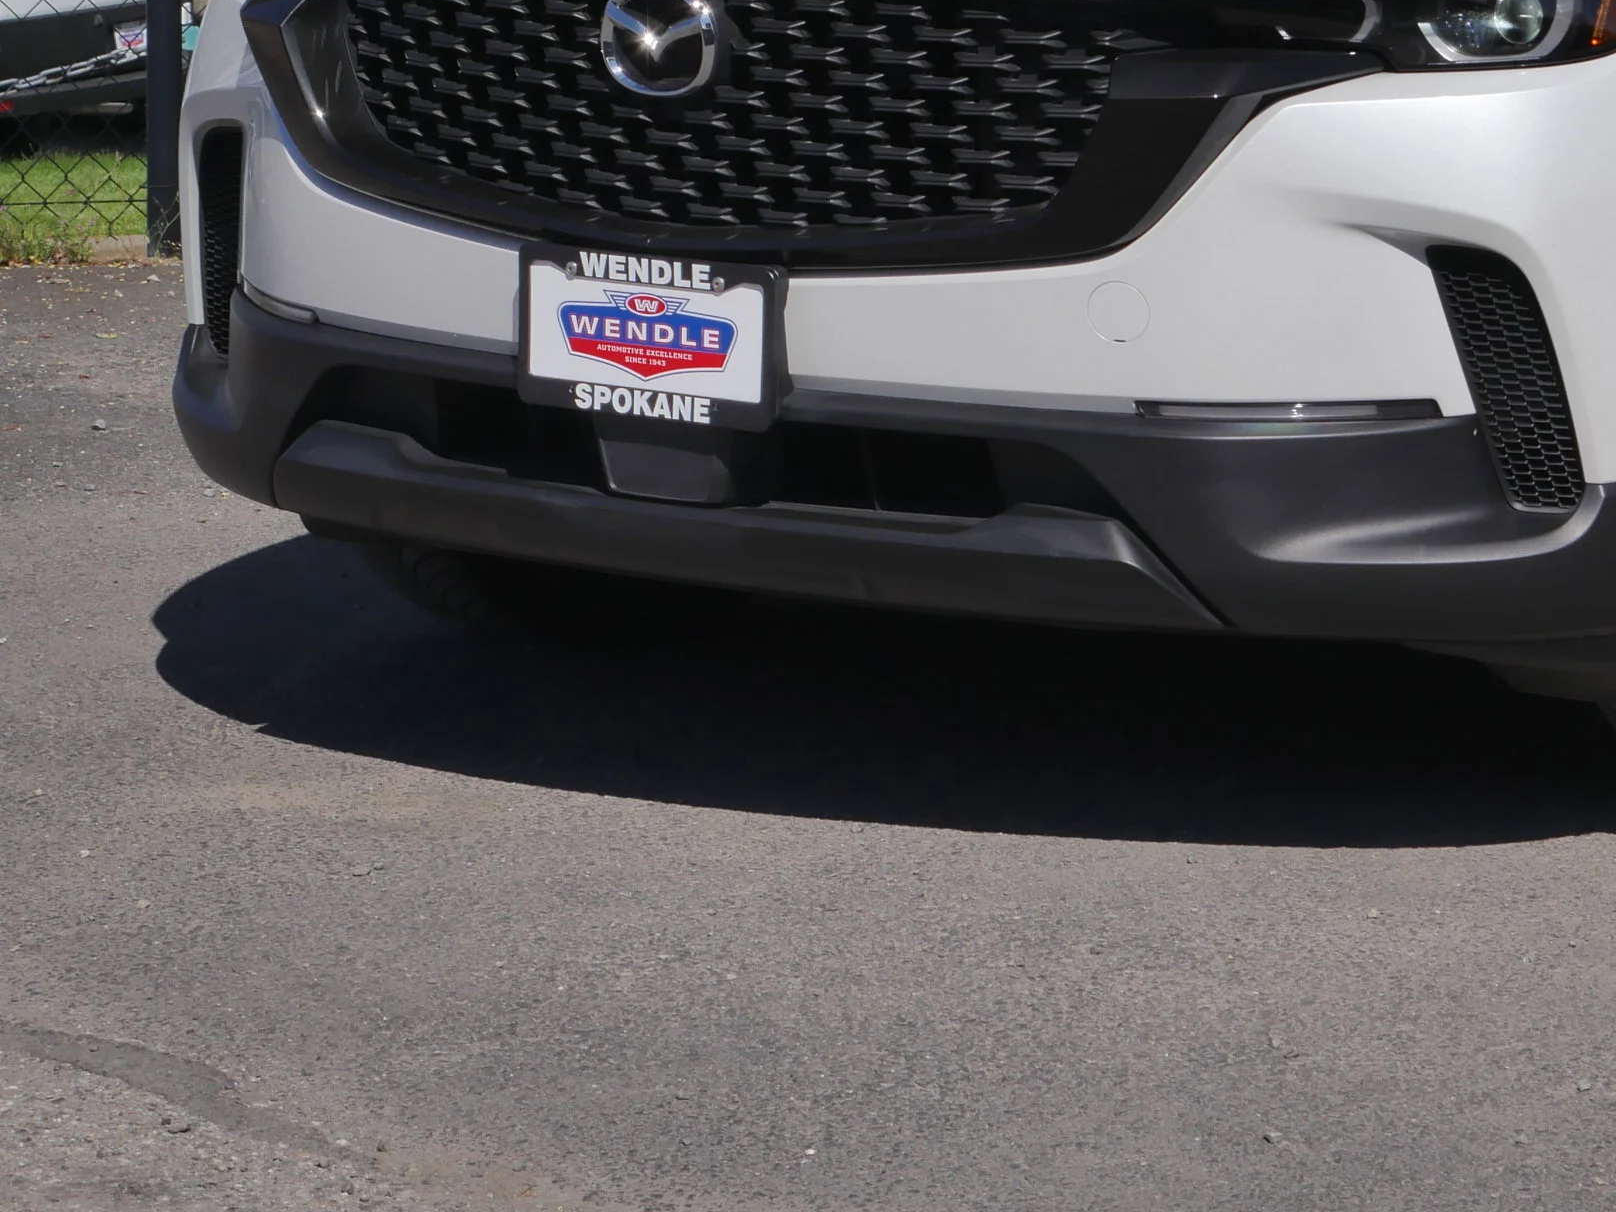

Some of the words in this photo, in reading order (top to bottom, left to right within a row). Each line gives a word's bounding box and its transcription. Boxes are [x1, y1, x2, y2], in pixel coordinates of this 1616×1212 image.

[579, 251, 711, 290] WENDLE
[569, 313, 720, 349] WENDLE
[597, 343, 644, 355] AUTOMOTIVE
[646, 349, 693, 361] EXCELLENCE
[625, 355, 647, 365] SINCE
[649, 358, 666, 367] 1943
[574, 382, 710, 425] SPOKANE
